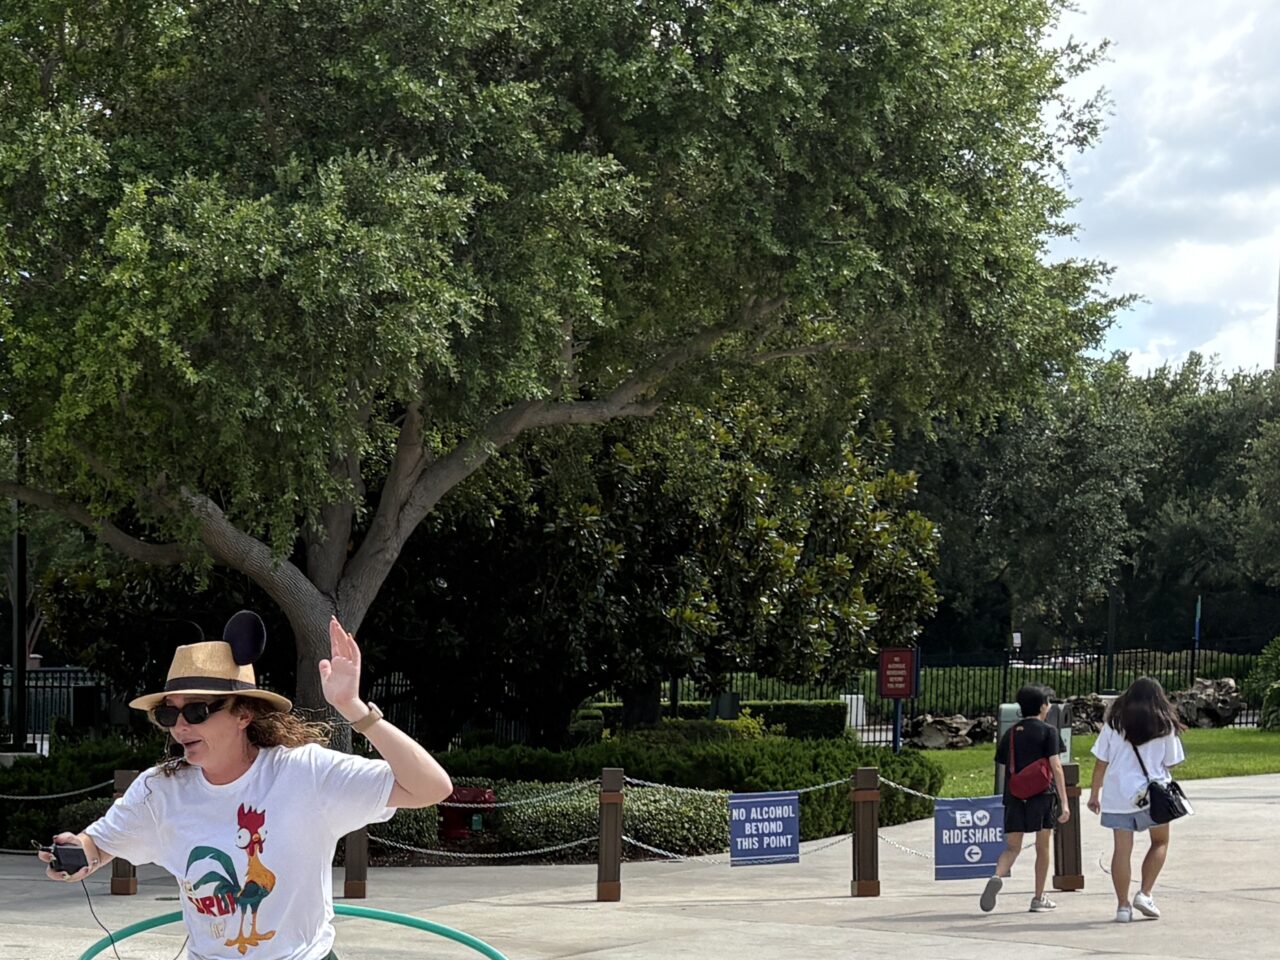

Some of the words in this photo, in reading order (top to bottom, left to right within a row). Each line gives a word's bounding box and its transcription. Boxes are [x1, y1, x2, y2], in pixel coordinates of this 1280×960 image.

[732, 808, 746, 820] NO
[750, 805, 795, 820] ALCOHOL
[745, 821, 783, 835] BEYOND
[942, 827, 1003, 844] RIDESHARE
[736, 836, 759, 850] THIS
[763, 835, 793, 848] POINT
